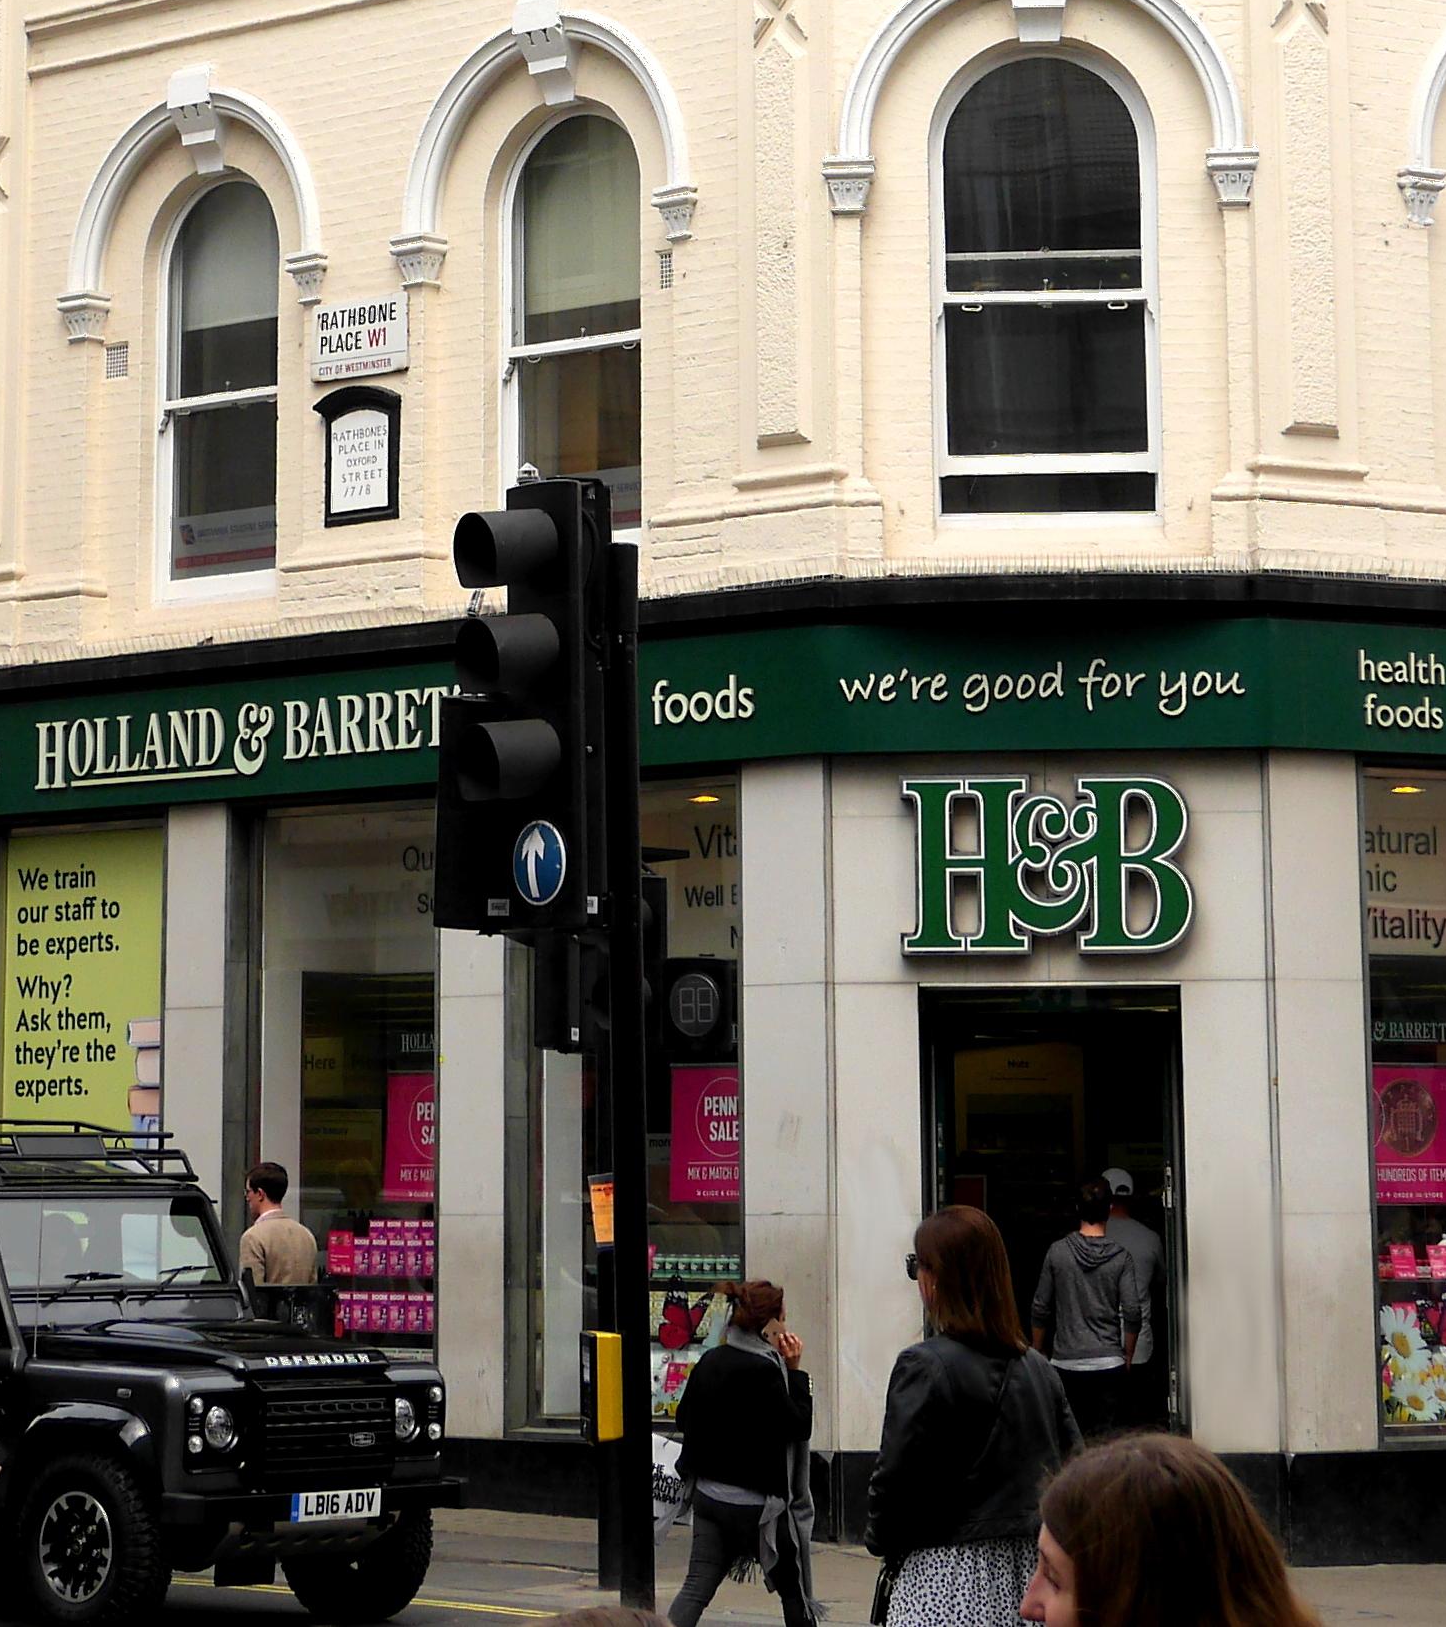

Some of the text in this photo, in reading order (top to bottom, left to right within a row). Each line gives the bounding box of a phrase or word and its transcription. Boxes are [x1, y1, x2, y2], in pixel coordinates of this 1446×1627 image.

[319, 302, 397, 331] RATHBONE
[320, 326, 387, 355] PLACE W1
[319, 358, 392, 376] CITY OF WESTMINSTER
[332, 425, 387, 442] RATHBONES
[338, 439, 384, 455] PLACE IN
[347, 455, 378, 468] OXFORD
[341, 468, 384, 484] STREET
[1359, 649, 1446, 687] health
[652, 673, 755, 726] foods
[839, 658, 1247, 717] we're good for you
[1364, 694, 1443, 732] foods
[34, 701, 275, 790] HOLLAND &
[900, 774, 1196, 955] H&B
[18, 864, 96, 892] We train
[685, 885, 723, 908] Well
[17, 897, 120, 924] our staff to
[17, 931, 119, 963] be experts.
[17, 974, 72, 1004] Why?
[16, 1007, 111, 1033] Ask them,
[1389, 1021, 1446, 1042] BARRETT
[15, 1040, 116, 1069] they're the
[15, 1075, 88, 1103] experts.
[709, 1121, 739, 1141] SALE
[400, 1169, 412, 1181] MIX
[688, 1166, 733, 1180] MIX MATCH
[1377, 1168, 1416, 1182] HUNDREDS
[1418, 1168, 1427, 1182] OF
[265, 1353, 371, 1367] DEFENDER
[305, 1491, 375, 1517] LB16 ADV
